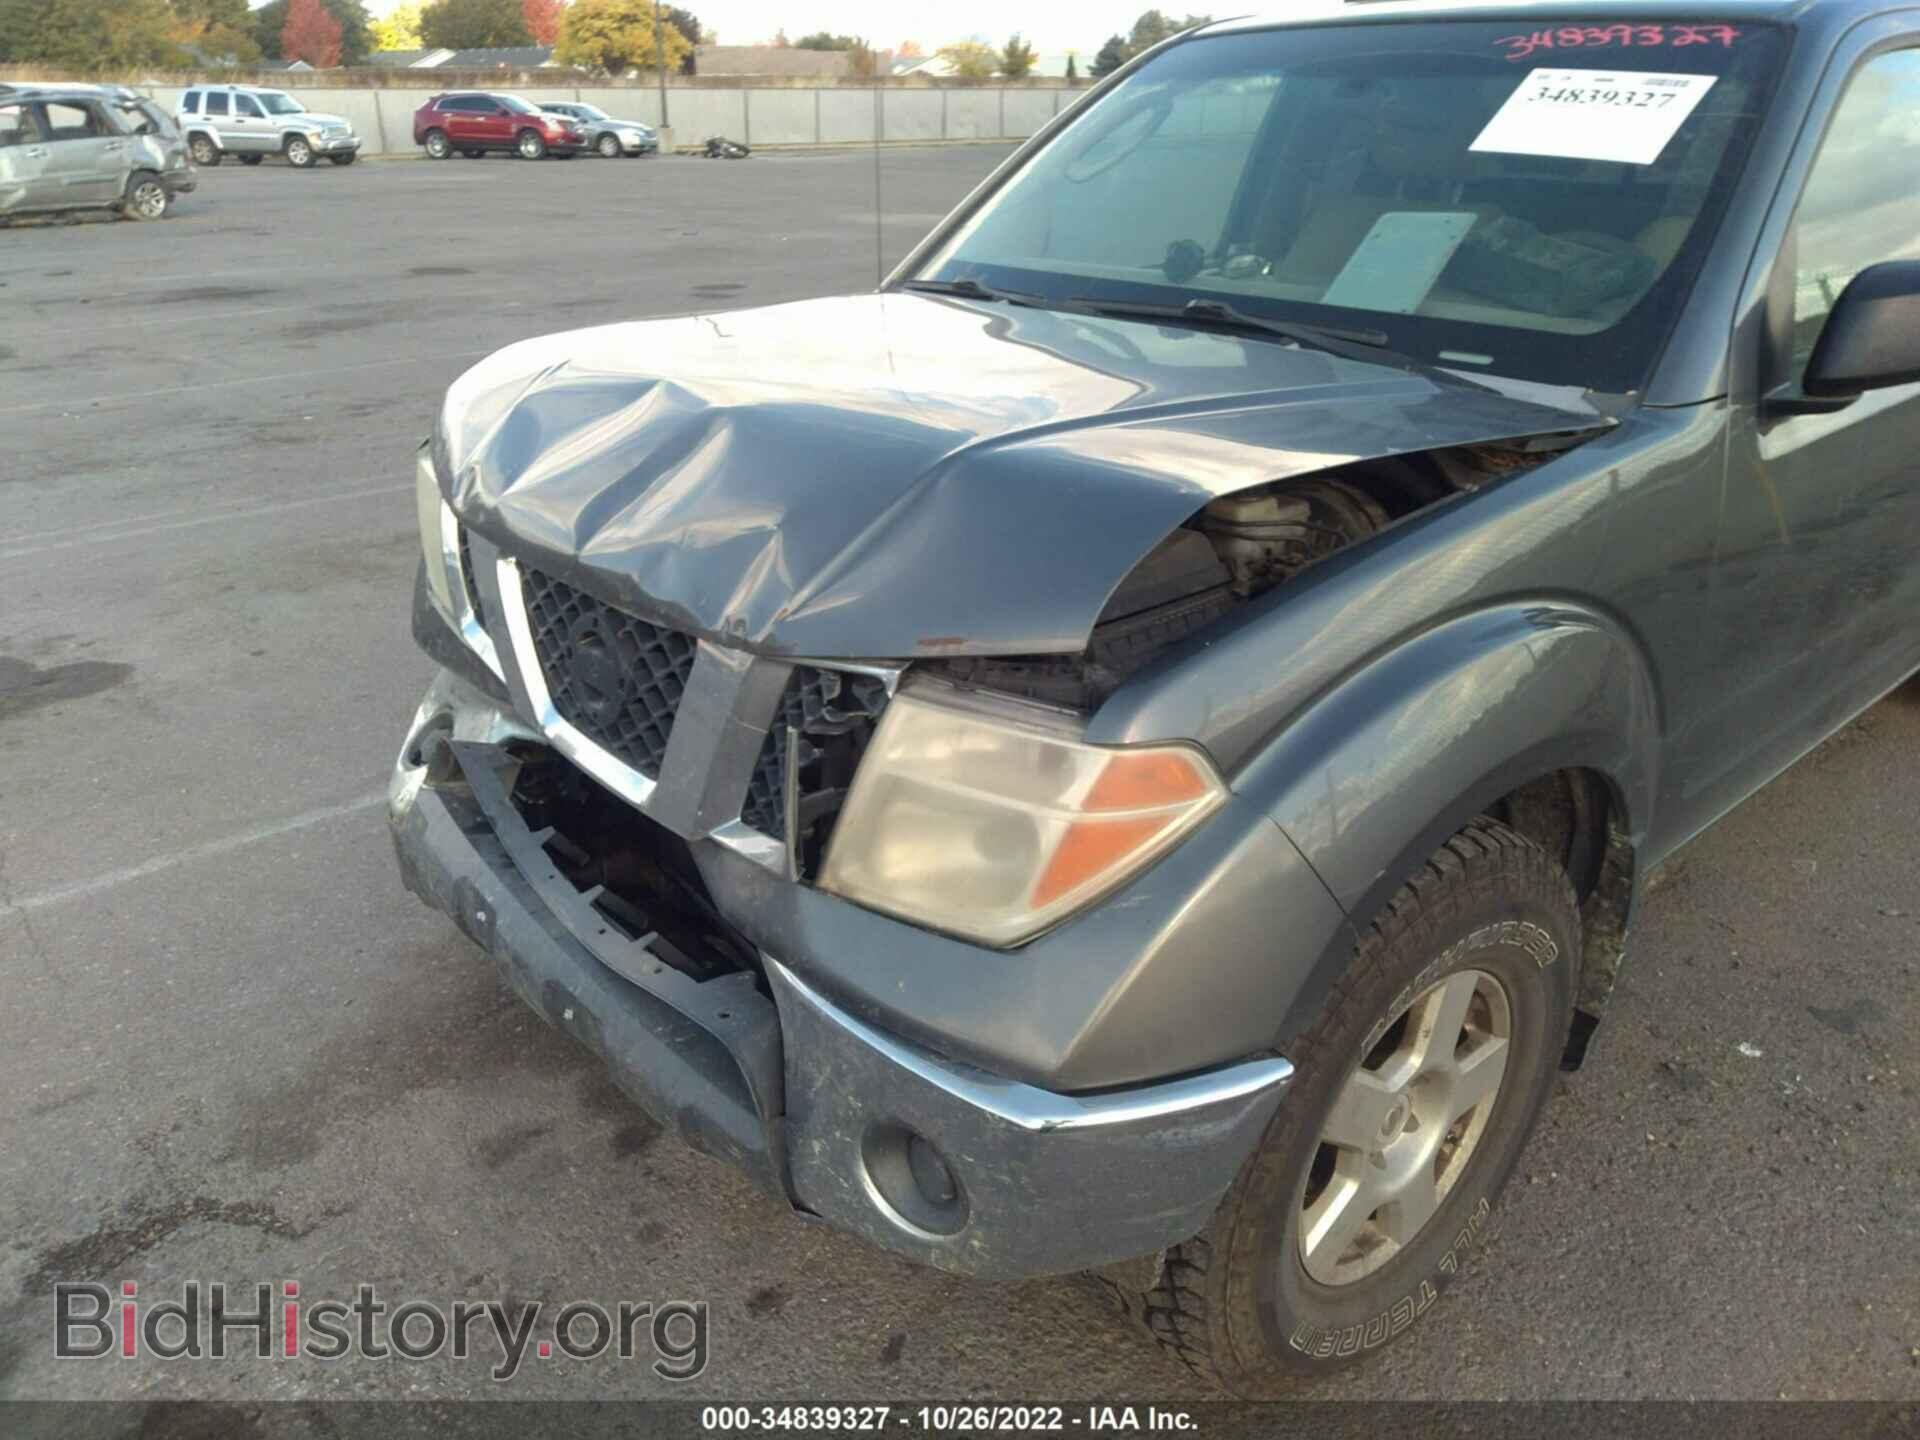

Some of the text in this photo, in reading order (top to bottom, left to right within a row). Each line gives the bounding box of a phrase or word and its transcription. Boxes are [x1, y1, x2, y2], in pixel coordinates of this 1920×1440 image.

[1493, 25, 1740, 61] 34839327
[1527, 87, 1677, 108] 34839327
[1289, 1279, 1437, 1358] TERRAIN
